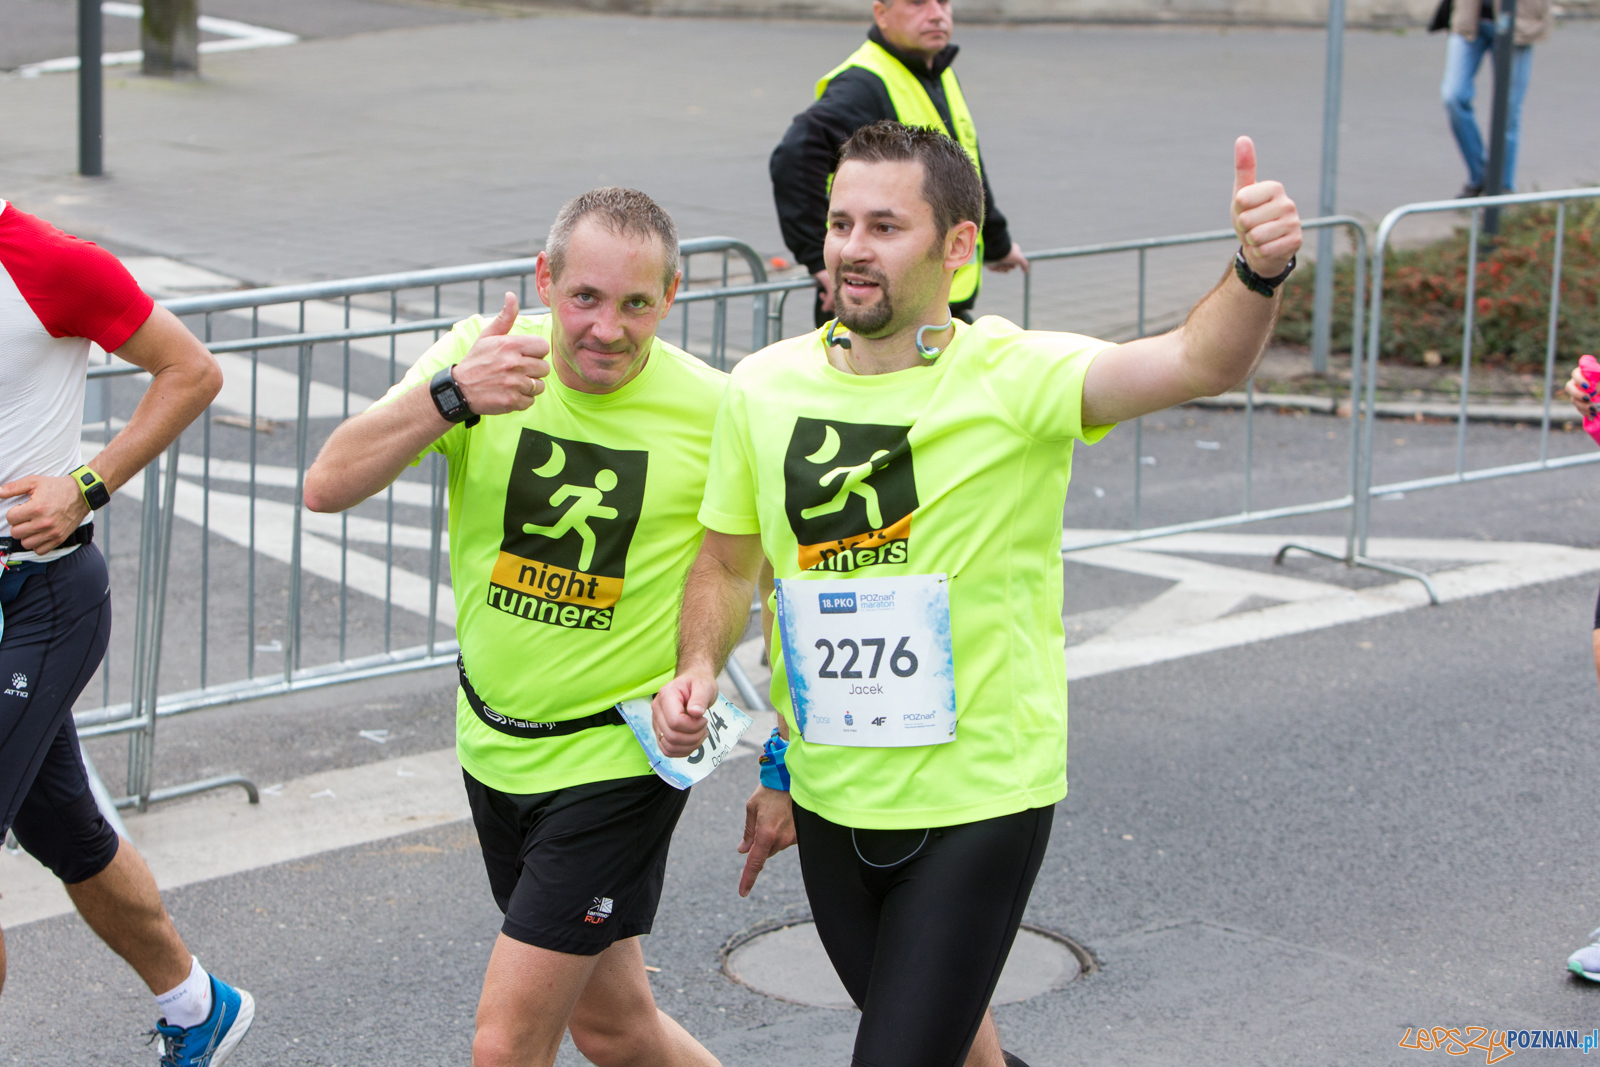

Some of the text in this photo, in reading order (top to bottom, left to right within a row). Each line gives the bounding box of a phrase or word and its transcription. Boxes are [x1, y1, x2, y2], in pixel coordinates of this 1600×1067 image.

[518, 563, 598, 600] night
[488, 585, 611, 630] runners
[860, 601, 895, 609] maraton
[814, 636, 918, 679] 2276
[3, 688, 29, 698] ATTIQ
[848, 683, 884, 695] Jacek
[507, 717, 557, 730] Kalenji
[871, 716, 887, 726] 4F
